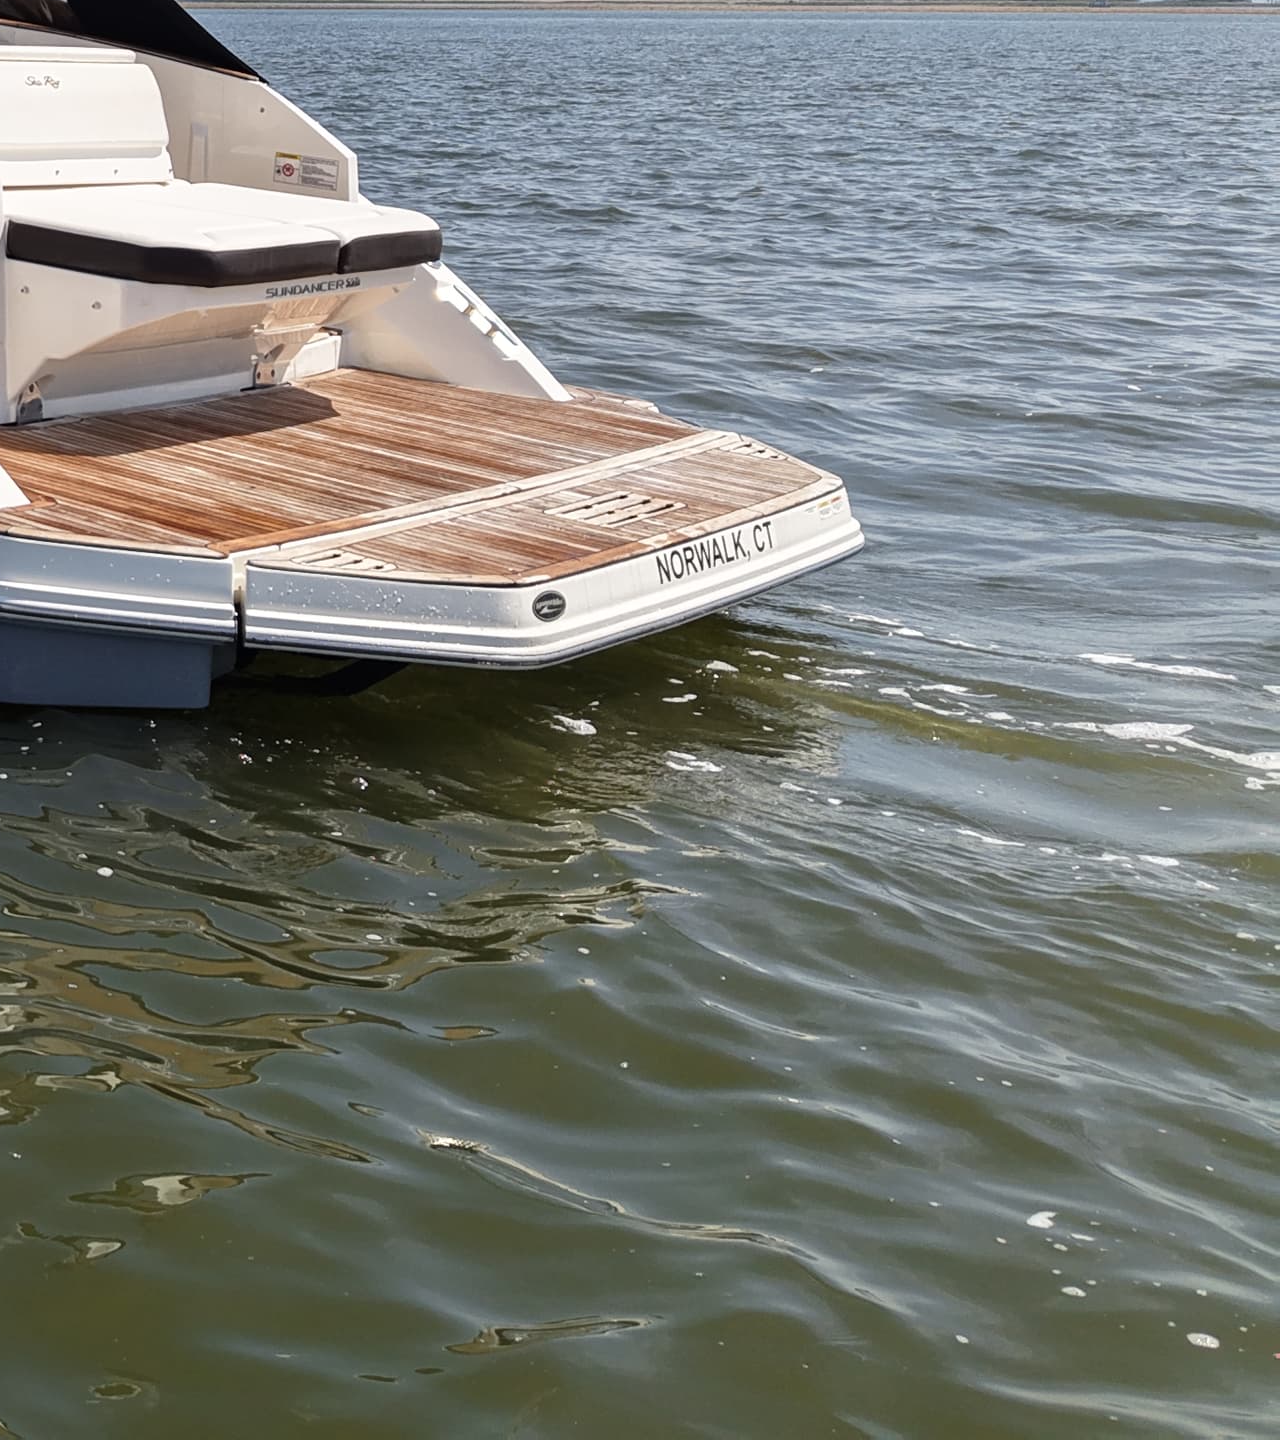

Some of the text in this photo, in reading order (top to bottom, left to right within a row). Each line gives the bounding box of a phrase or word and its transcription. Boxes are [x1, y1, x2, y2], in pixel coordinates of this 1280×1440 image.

[266, 280, 344, 298] SUNDANCER
[656, 521, 773, 585] NORWALK, CT
